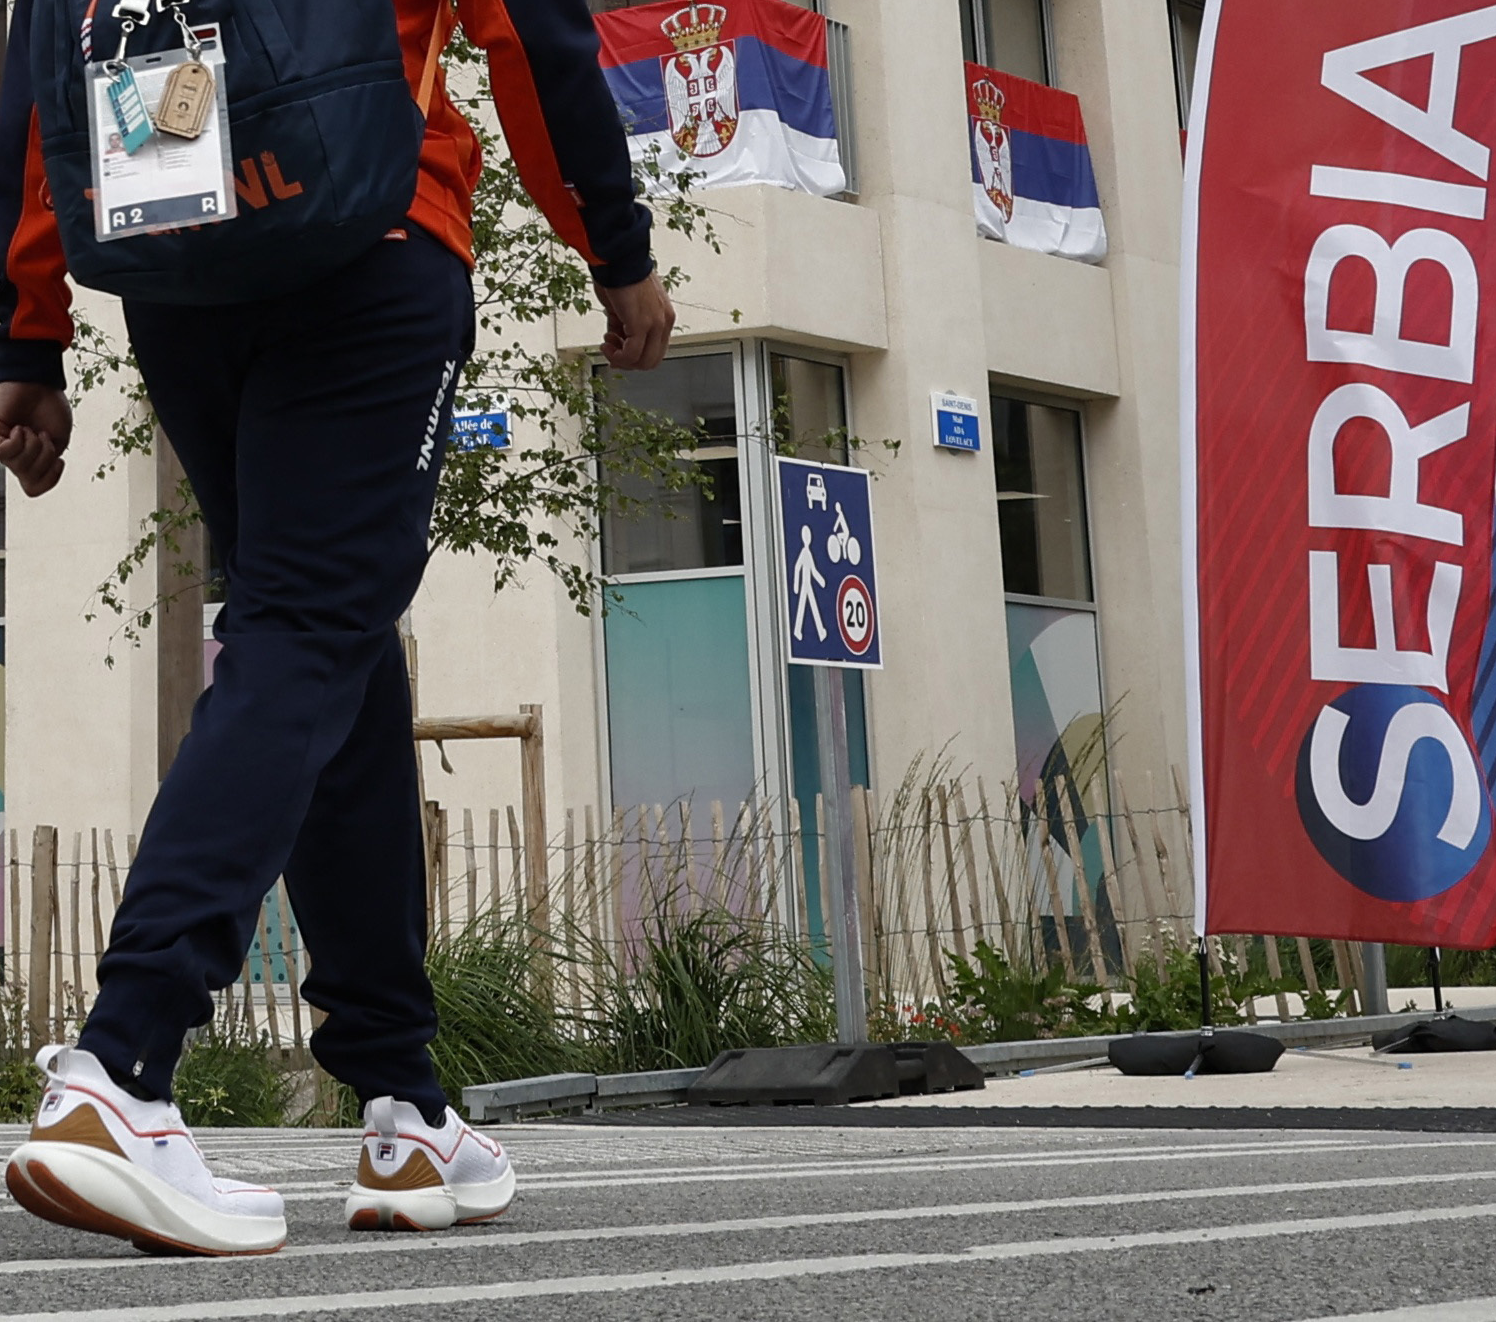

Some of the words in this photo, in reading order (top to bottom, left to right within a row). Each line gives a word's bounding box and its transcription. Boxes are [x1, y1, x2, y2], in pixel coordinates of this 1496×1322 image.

[112, 211, 126, 227] A
[130, 208, 144, 224] 2
[201, 197, 216, 214] R
[416, 360, 456, 472] TeamNL
[480, 418, 493, 430] de
[844, 599, 867, 629] 20
